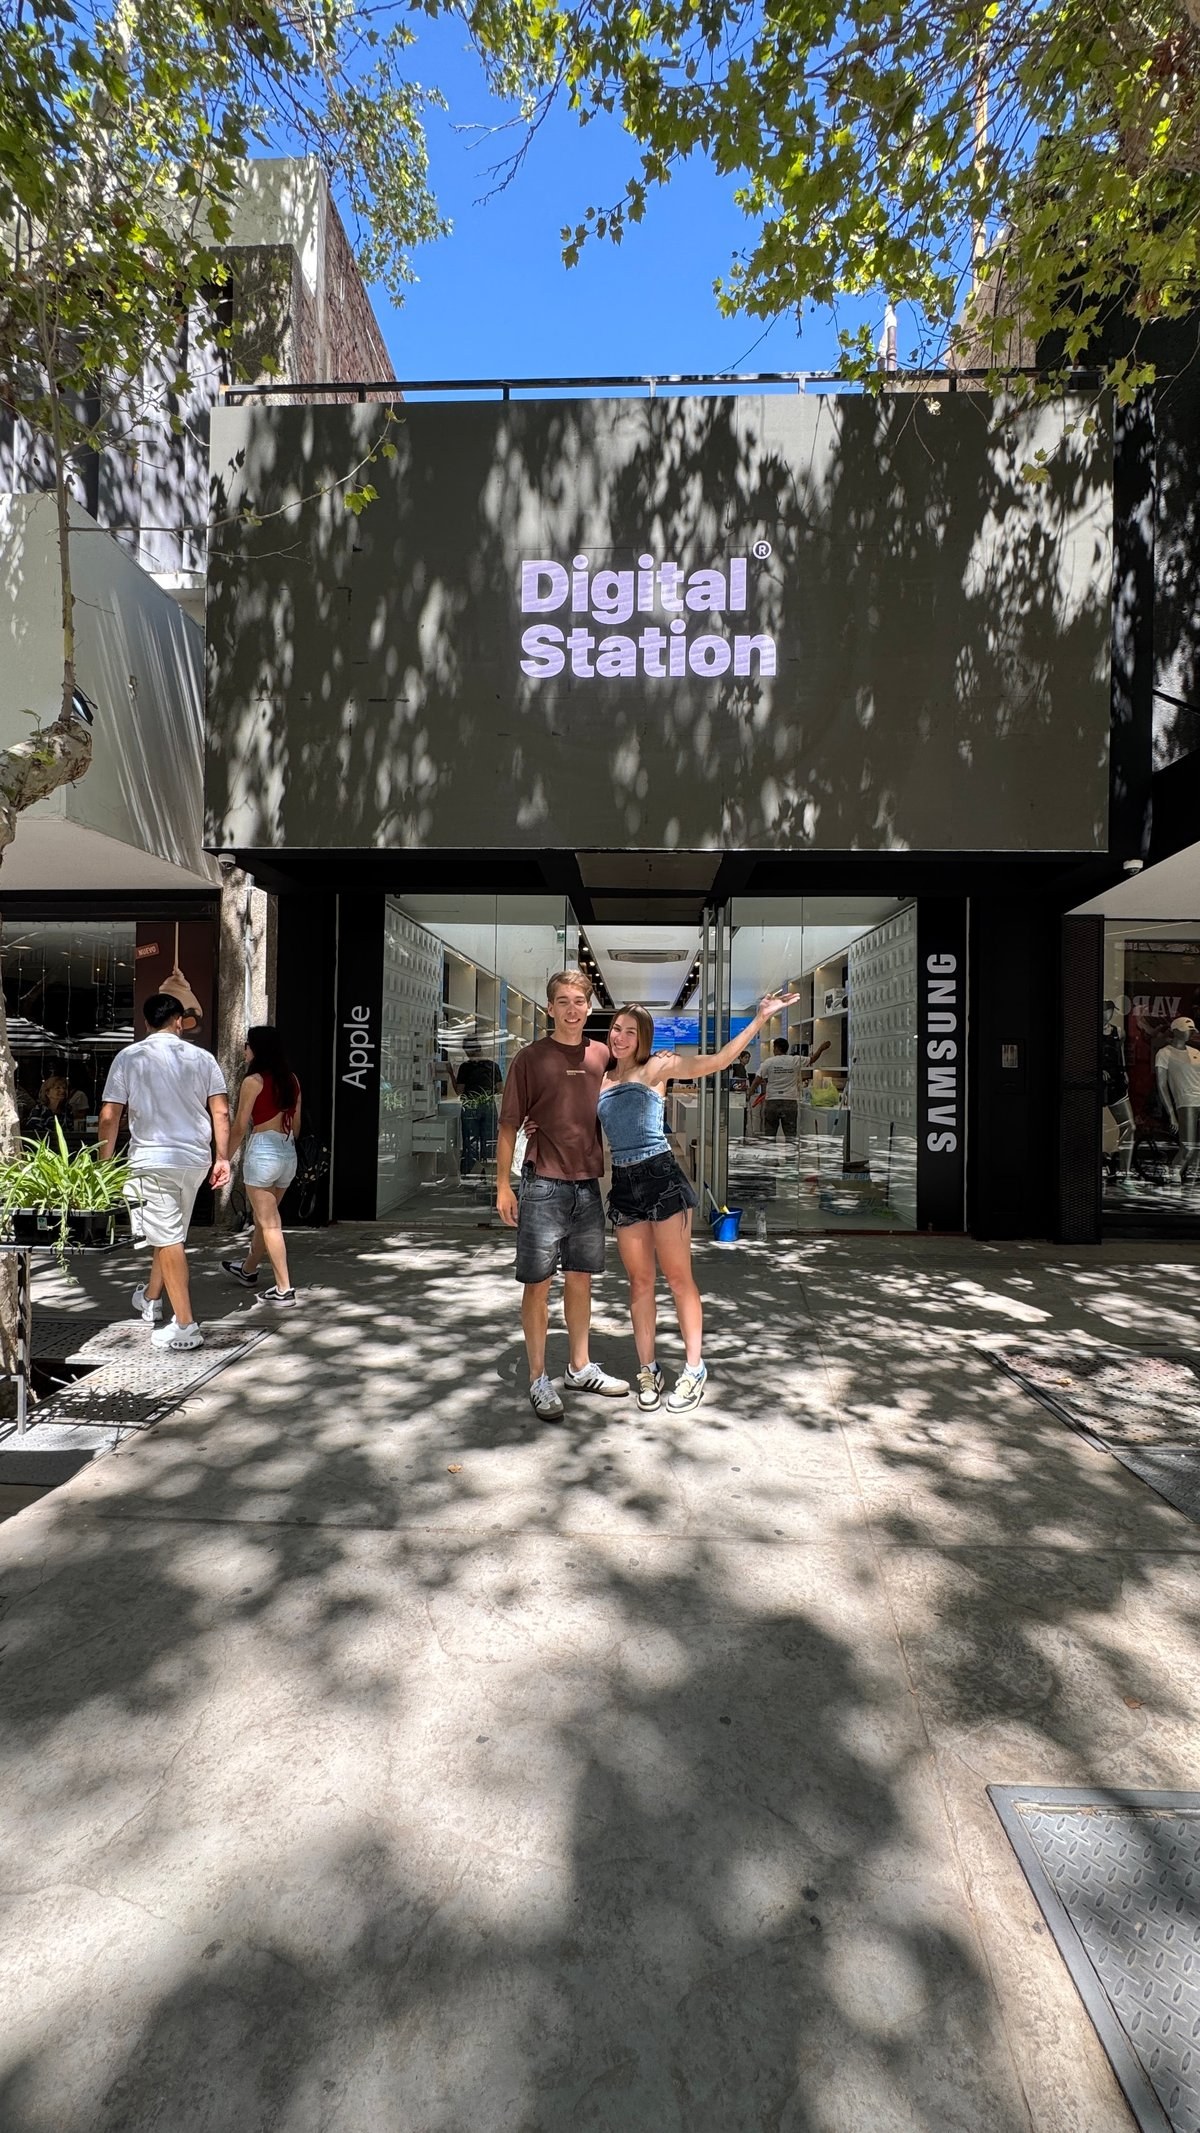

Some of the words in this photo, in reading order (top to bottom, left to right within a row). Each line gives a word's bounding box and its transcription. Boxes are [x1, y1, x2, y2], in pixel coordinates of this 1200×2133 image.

[521, 554, 747, 625] Digital
[520, 618, 777, 679] Station
[138, 945, 156, 956] NUEVO
[341, 1005, 376, 1090] Apple
[926, 953, 958, 1153] SAMSUNG
